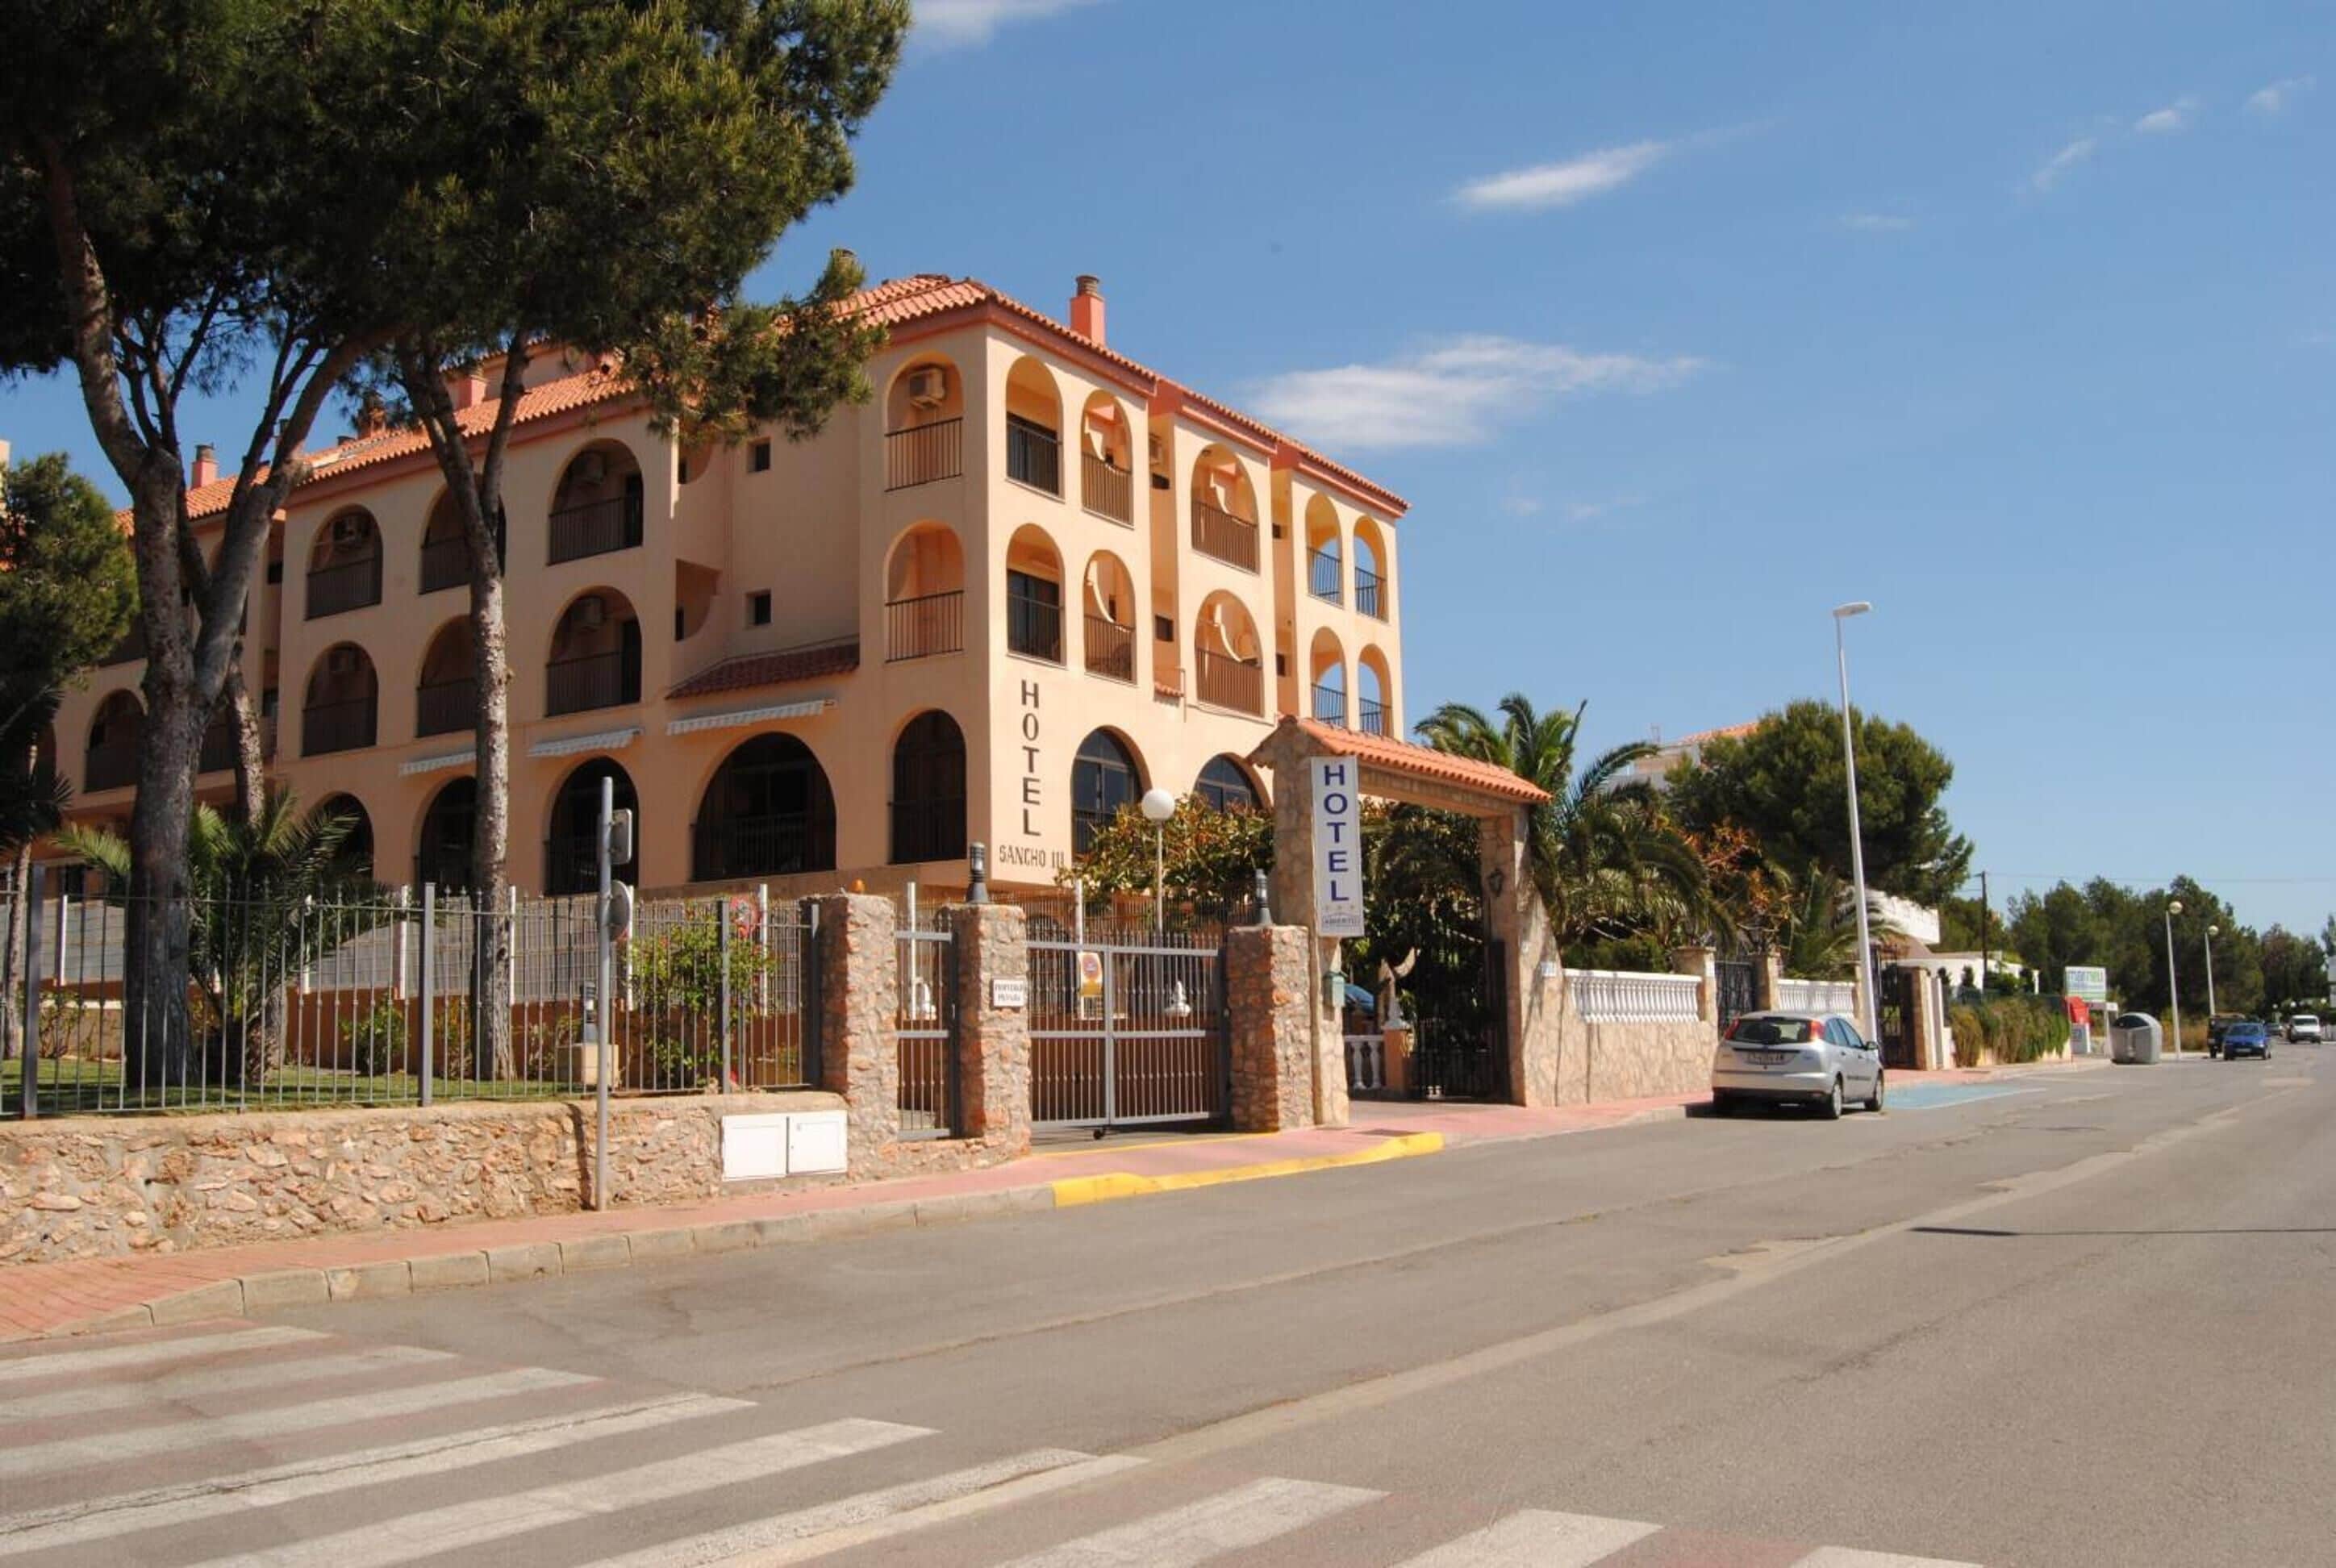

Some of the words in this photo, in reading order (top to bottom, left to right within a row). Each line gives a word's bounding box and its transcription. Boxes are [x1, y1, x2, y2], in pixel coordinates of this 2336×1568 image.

[1020, 679, 1041, 836] HOTEL
[999, 844, 1046, 868] SANCHO
[1324, 764, 1349, 902] HOTEL
